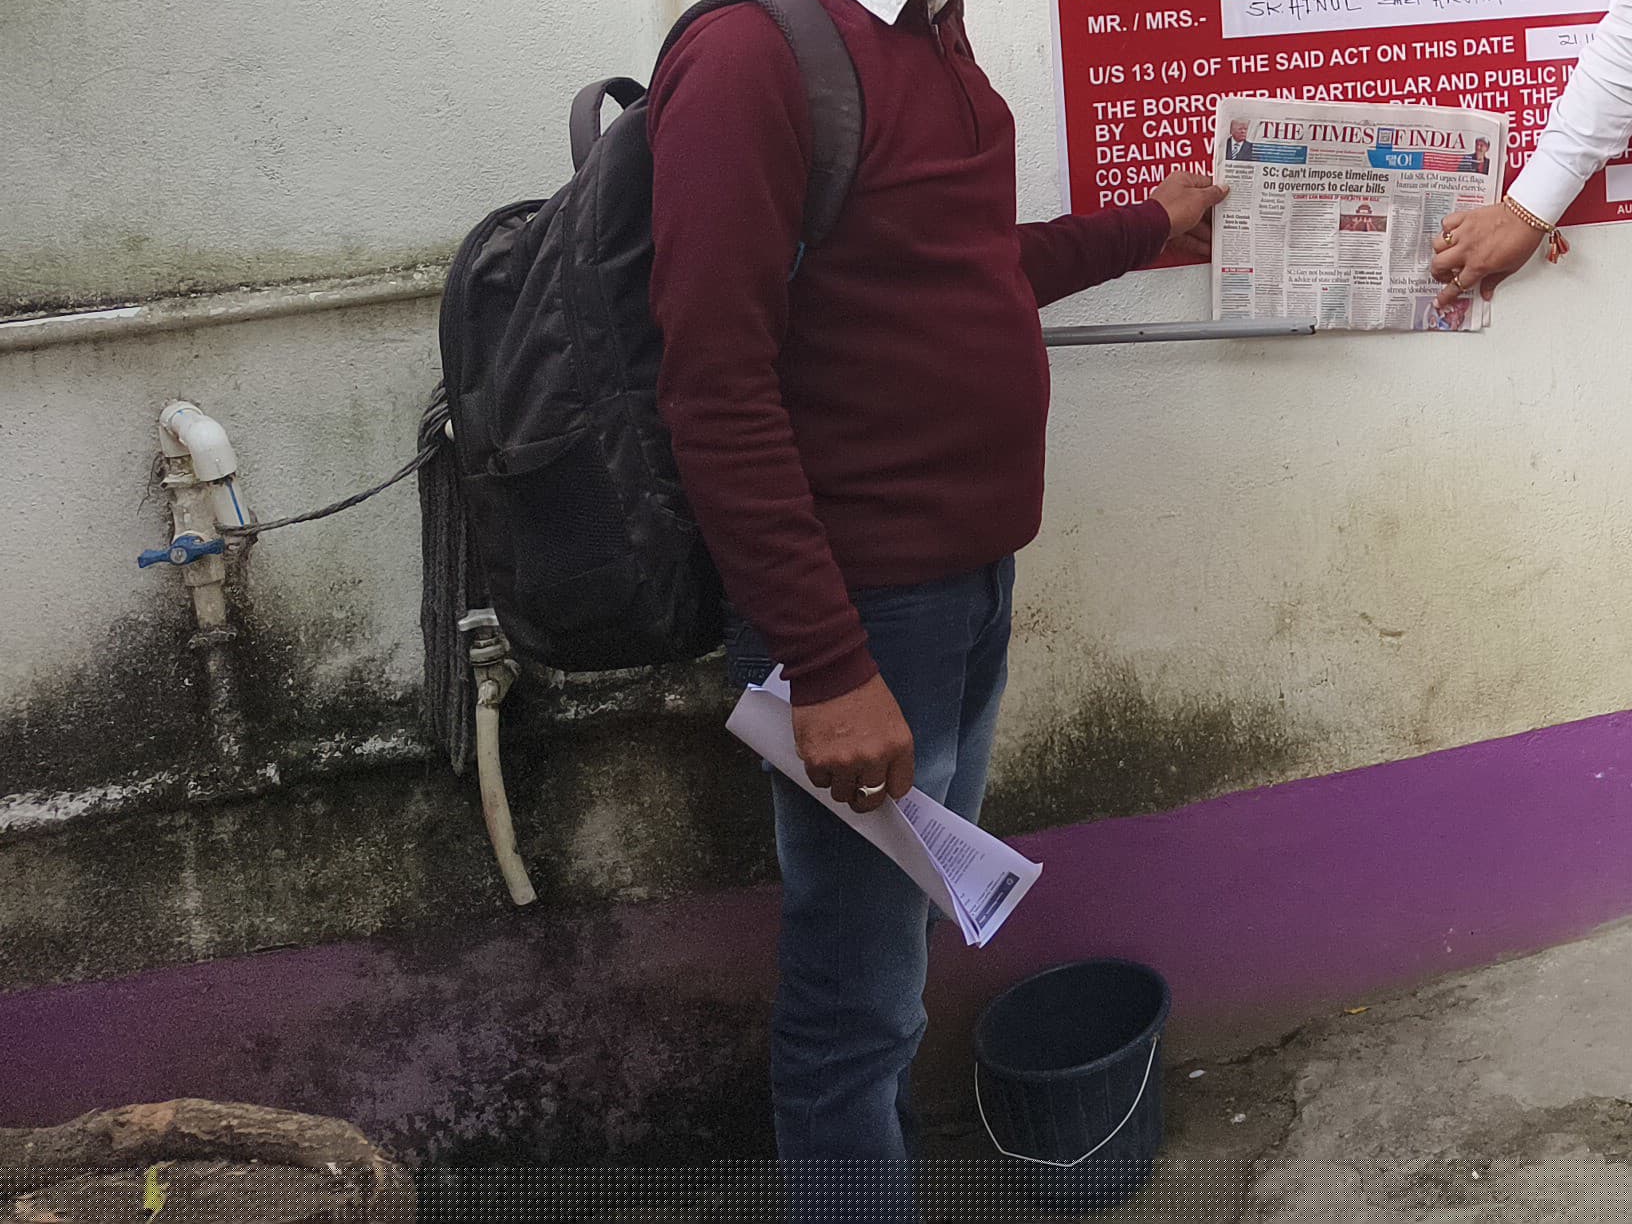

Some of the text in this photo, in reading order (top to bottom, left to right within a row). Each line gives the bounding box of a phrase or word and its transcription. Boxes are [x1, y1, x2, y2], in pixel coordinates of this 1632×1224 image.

[1087, 15, 1128, 35] MR.
[1145, 9, 1207, 30] MRS.-
[1089, 35, 1515, 85] U/S 13 (4) OF THE SAID ACT ON THIS DATE
[1092, 100, 1137, 120] THE
[1302, 76, 1432, 101] PARTICULAR
[1436, 73, 1480, 92] AND
[1485, 66, 1557, 88] PUBLIC
[1095, 123, 1125, 143] BY
[1458, 90, 1509, 111] WITH
[1520, 86, 1558, 106] THE
[1259, 121, 1305, 140] THE
[1308, 124, 1375, 145] TIMES
[1409, 129, 1467, 150] INDIA
[1096, 139, 1193, 165] DEALING
[1095, 168, 1122, 187] CO
[1126, 164, 1165, 185] SAM
[1262, 166, 1280, 177] SC:
[1281, 167, 1307, 178] Can't
[1308, 168, 1344, 181] impose
[1345, 169, 1390, 182] timelines
[1263, 181, 1386, 194] on governors to clear bills
